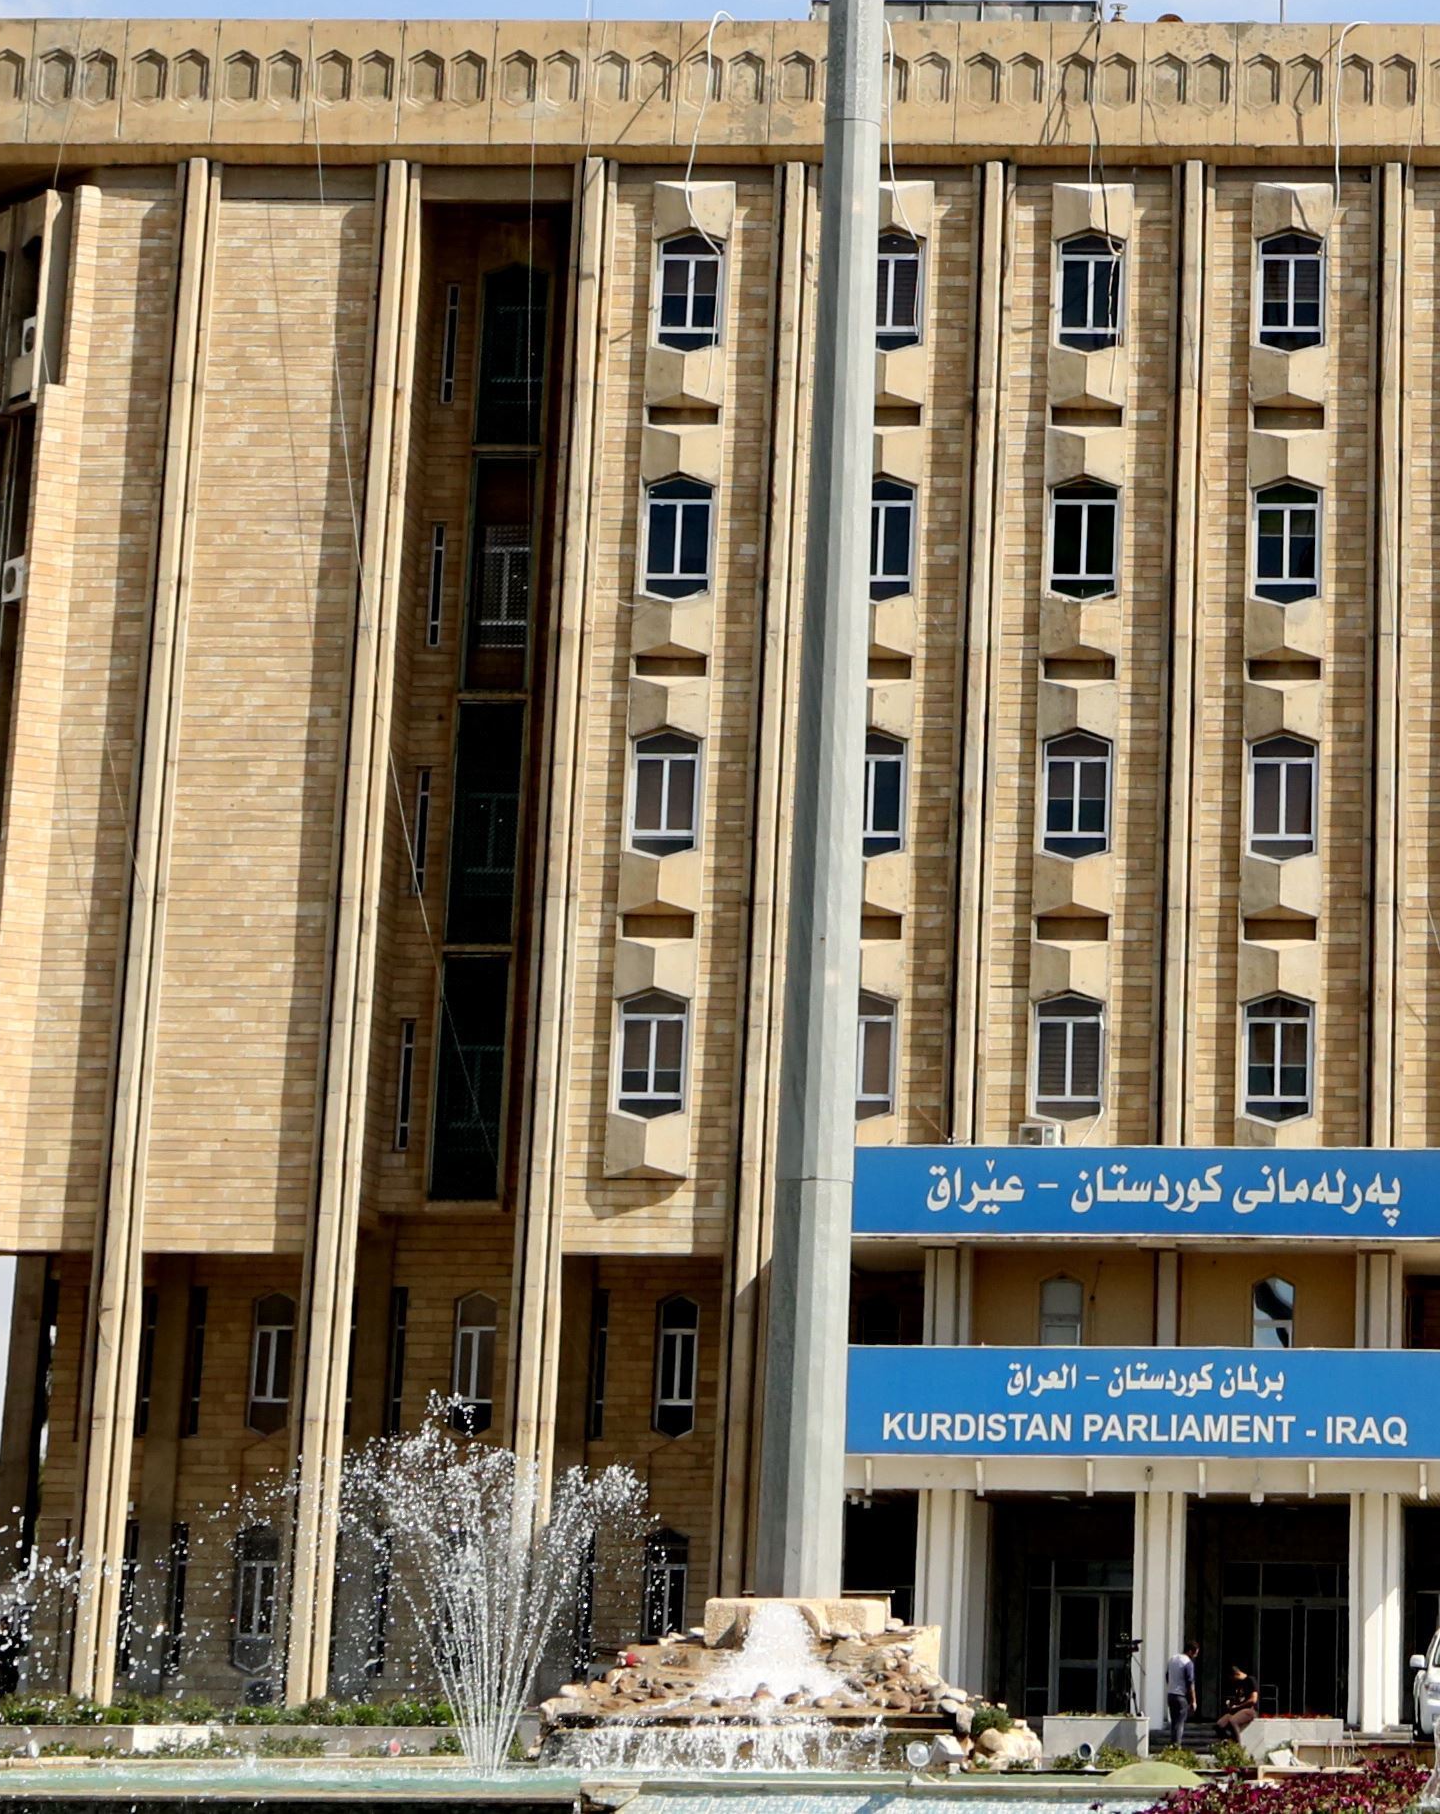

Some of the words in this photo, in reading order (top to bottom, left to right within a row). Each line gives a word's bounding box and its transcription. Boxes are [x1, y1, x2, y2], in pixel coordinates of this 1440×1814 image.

[1070, 1163, 1224, 1214] کوردستان
[1005, 1362, 1077, 1397] العراق
[1218, 1363, 1285, 1402] برلمان
[882, 1412, 1072, 1442] KURDISTAN
[1083, 1413, 1297, 1444] PARLIAMENT
[1325, 1415, 1408, 1447] IRAQ
